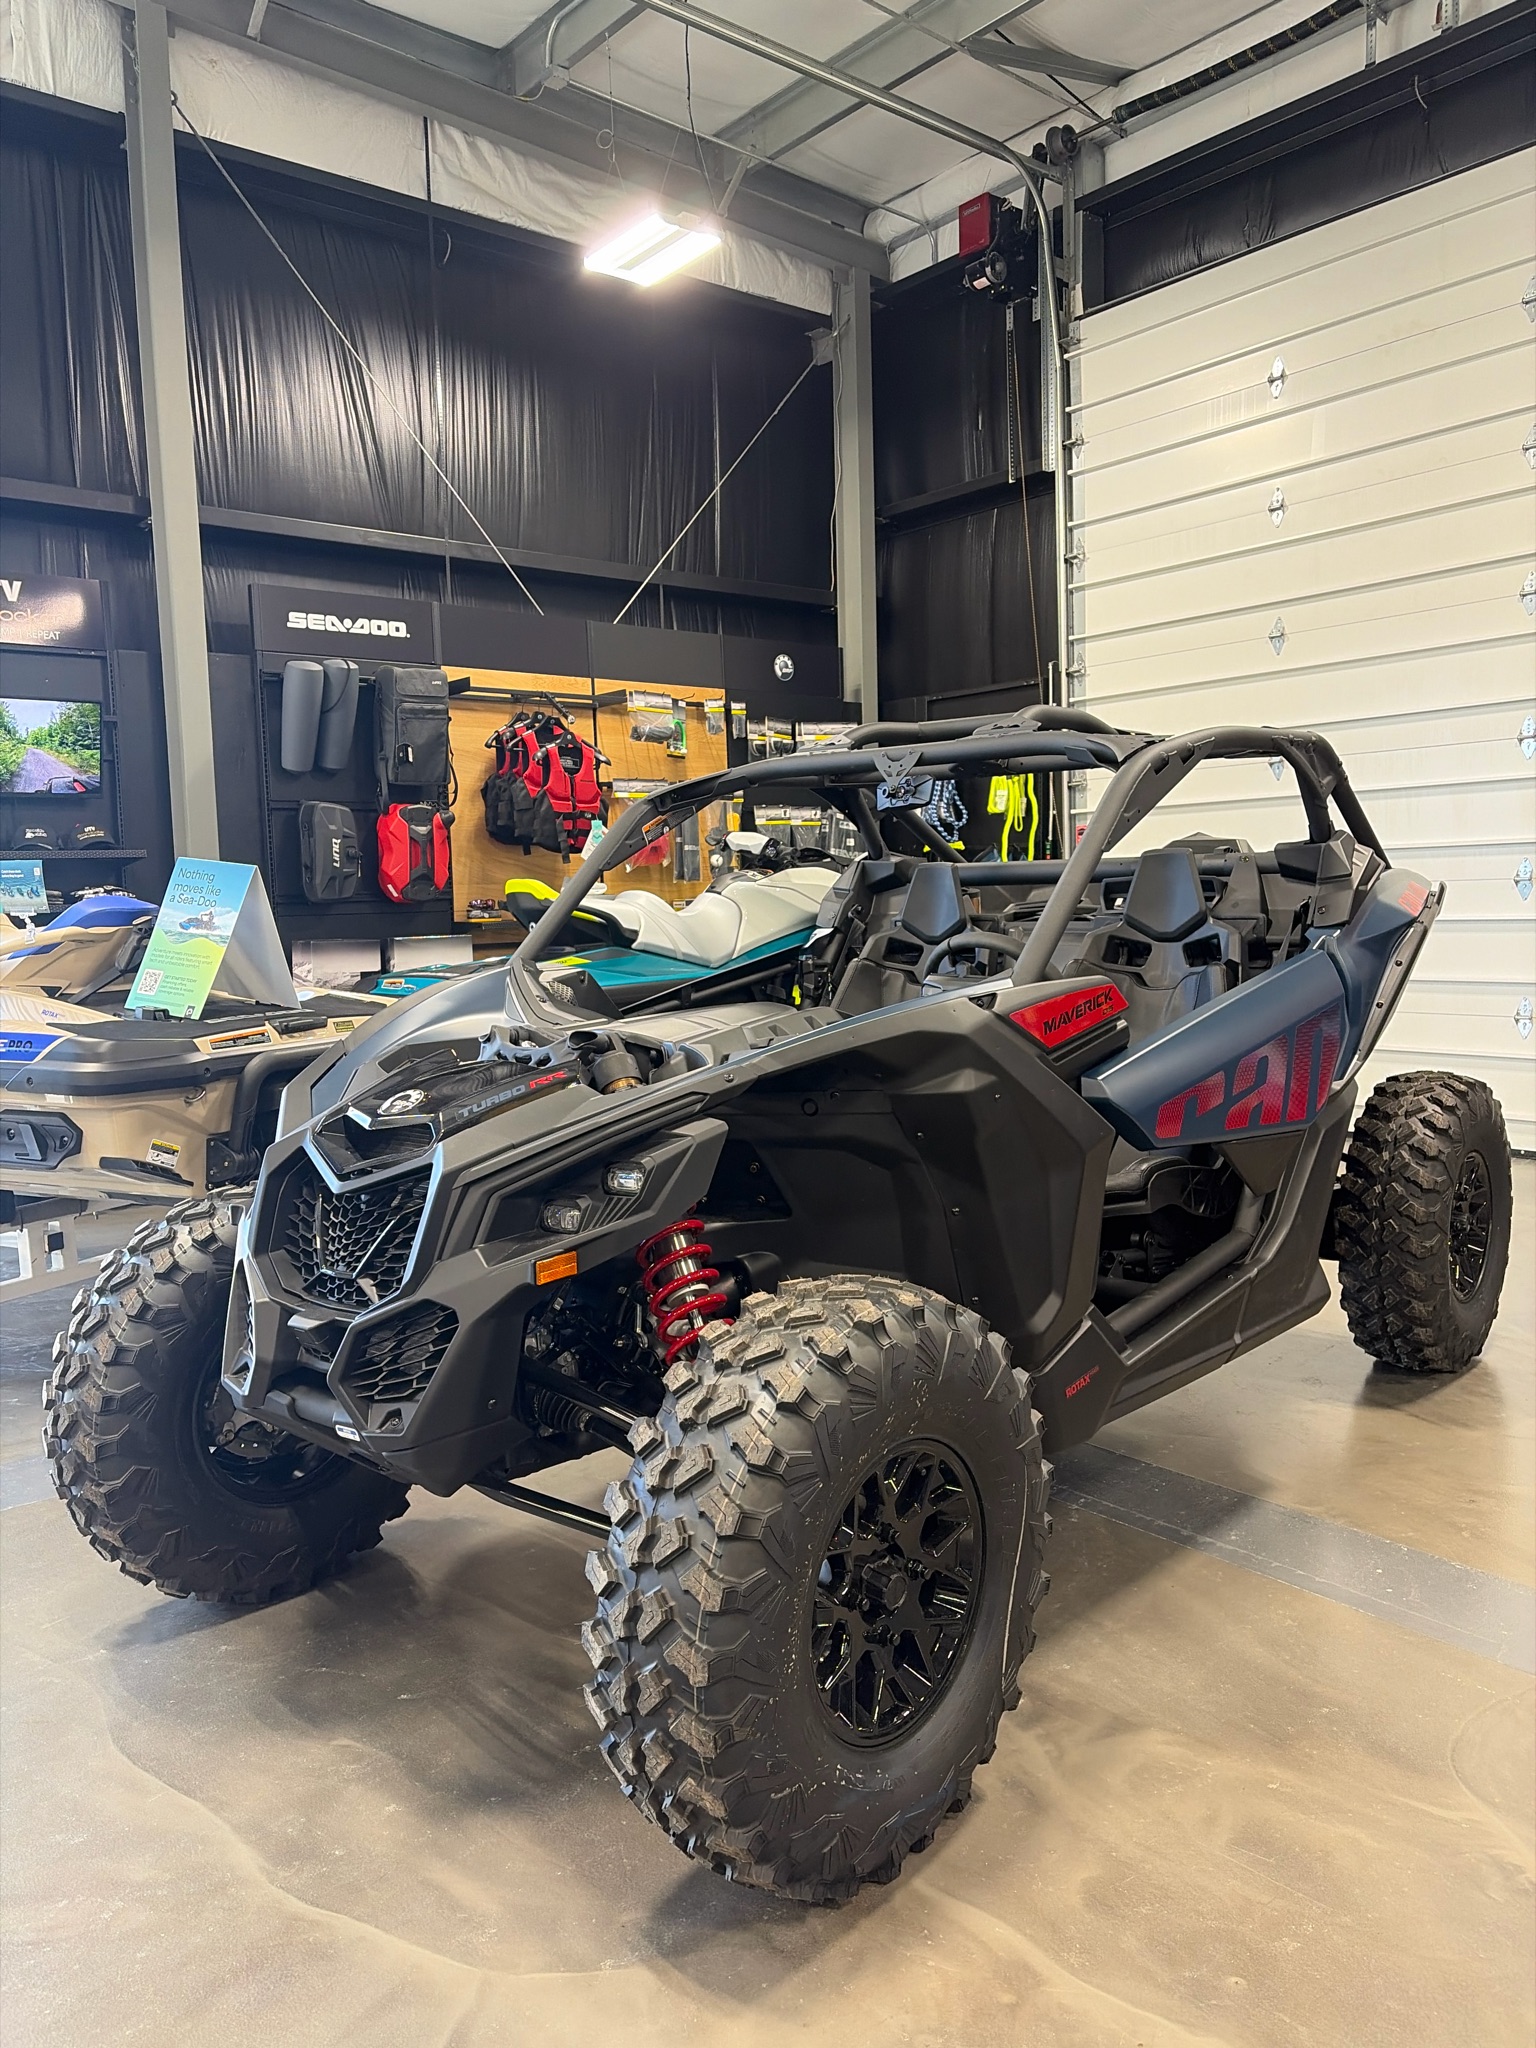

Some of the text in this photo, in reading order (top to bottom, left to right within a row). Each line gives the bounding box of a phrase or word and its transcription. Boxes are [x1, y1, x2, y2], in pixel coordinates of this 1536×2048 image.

[26, 630, 60, 640] REPEAT
[177, 868, 215, 884] Nothing
[173, 883, 221, 897] moves like
[169, 893, 217, 907] a Sea-Doo
[41, 1009, 58, 1018] ROTAX
[1043, 988, 1113, 1035] MAVERICK
[8, 1040, 33, 1053] PRO
[457, 1070, 567, 1119] TURBO RR
[1065, 1373, 1090, 1398] ROTAX
